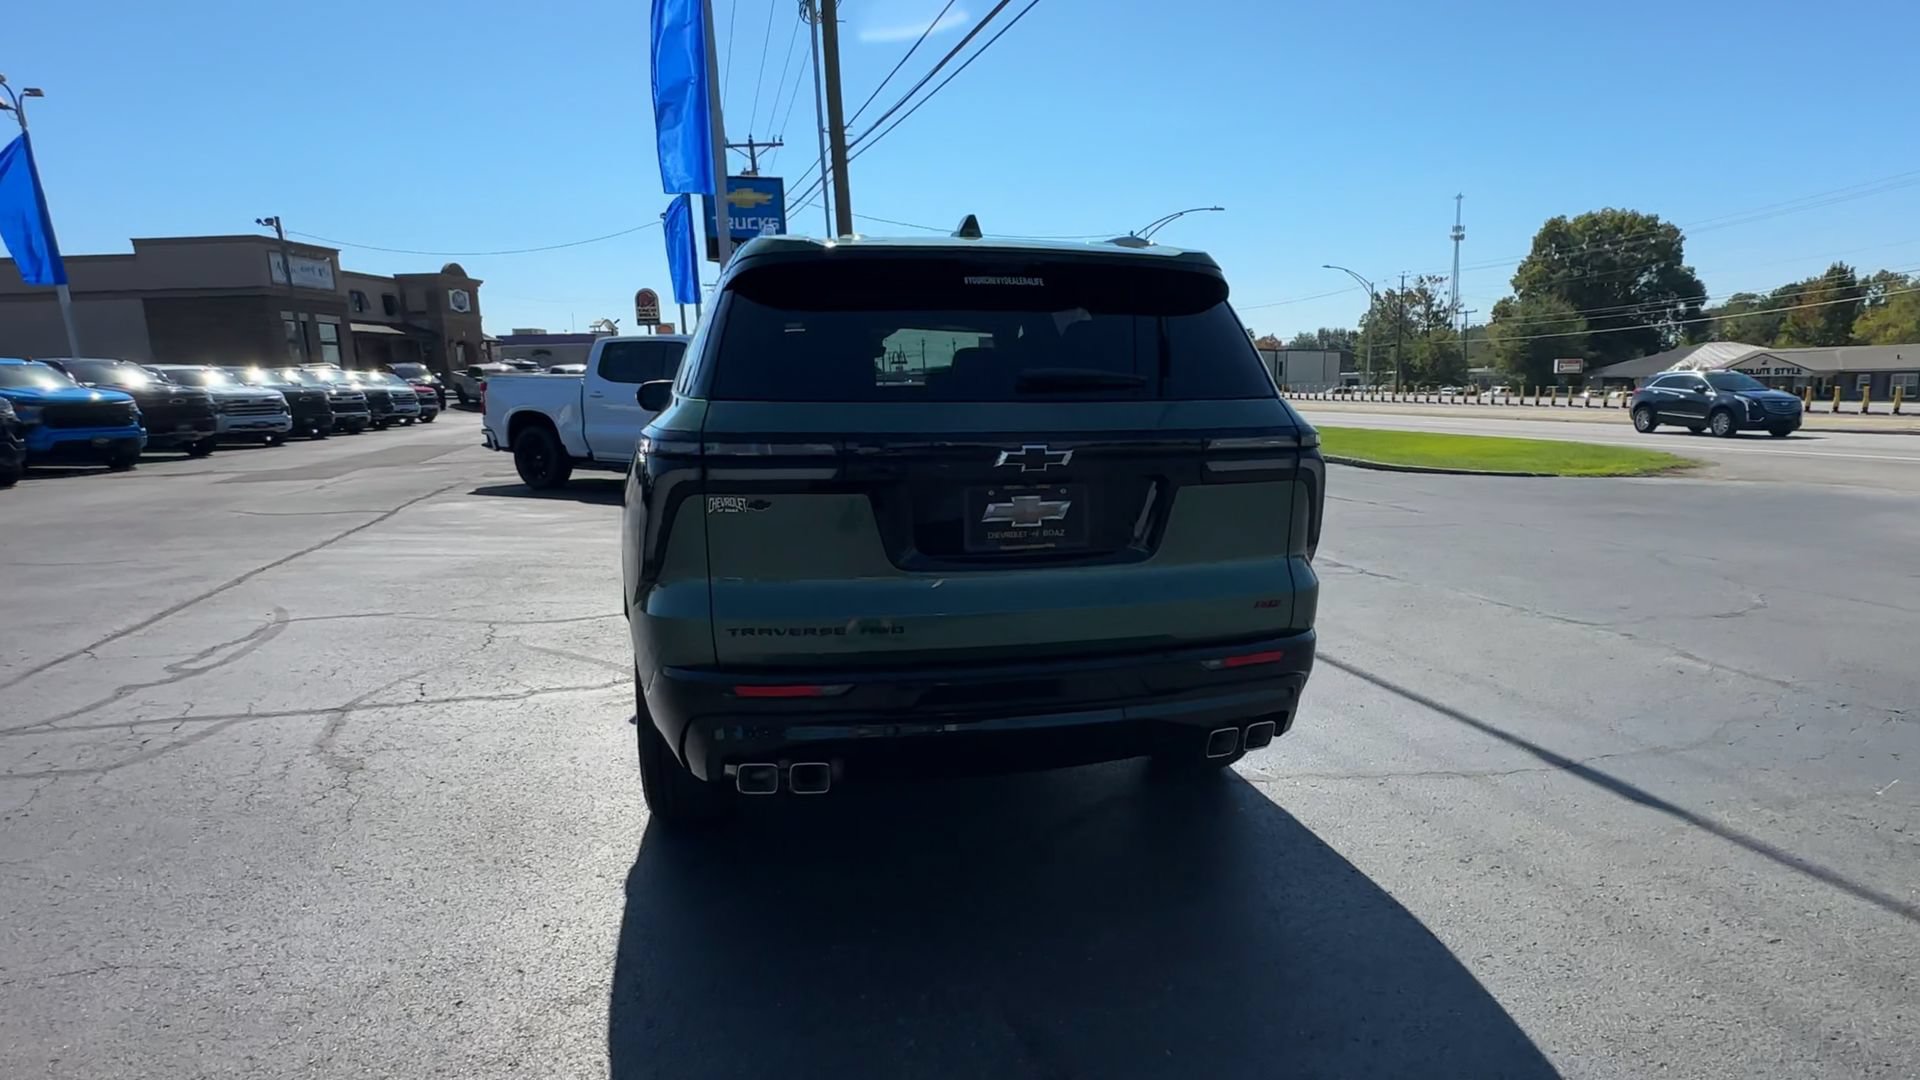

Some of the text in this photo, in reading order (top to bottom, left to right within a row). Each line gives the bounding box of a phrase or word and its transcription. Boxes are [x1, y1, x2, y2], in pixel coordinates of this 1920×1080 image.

[1736, 367, 1803, 376] SOLUTE STYLE
[708, 496, 747, 513] CHEVROLET
[987, 530, 1028, 540] CHEVROLET
[1042, 529, 1065, 538] BOAZ
[726, 624, 905, 638] TRAVERSE AWD
